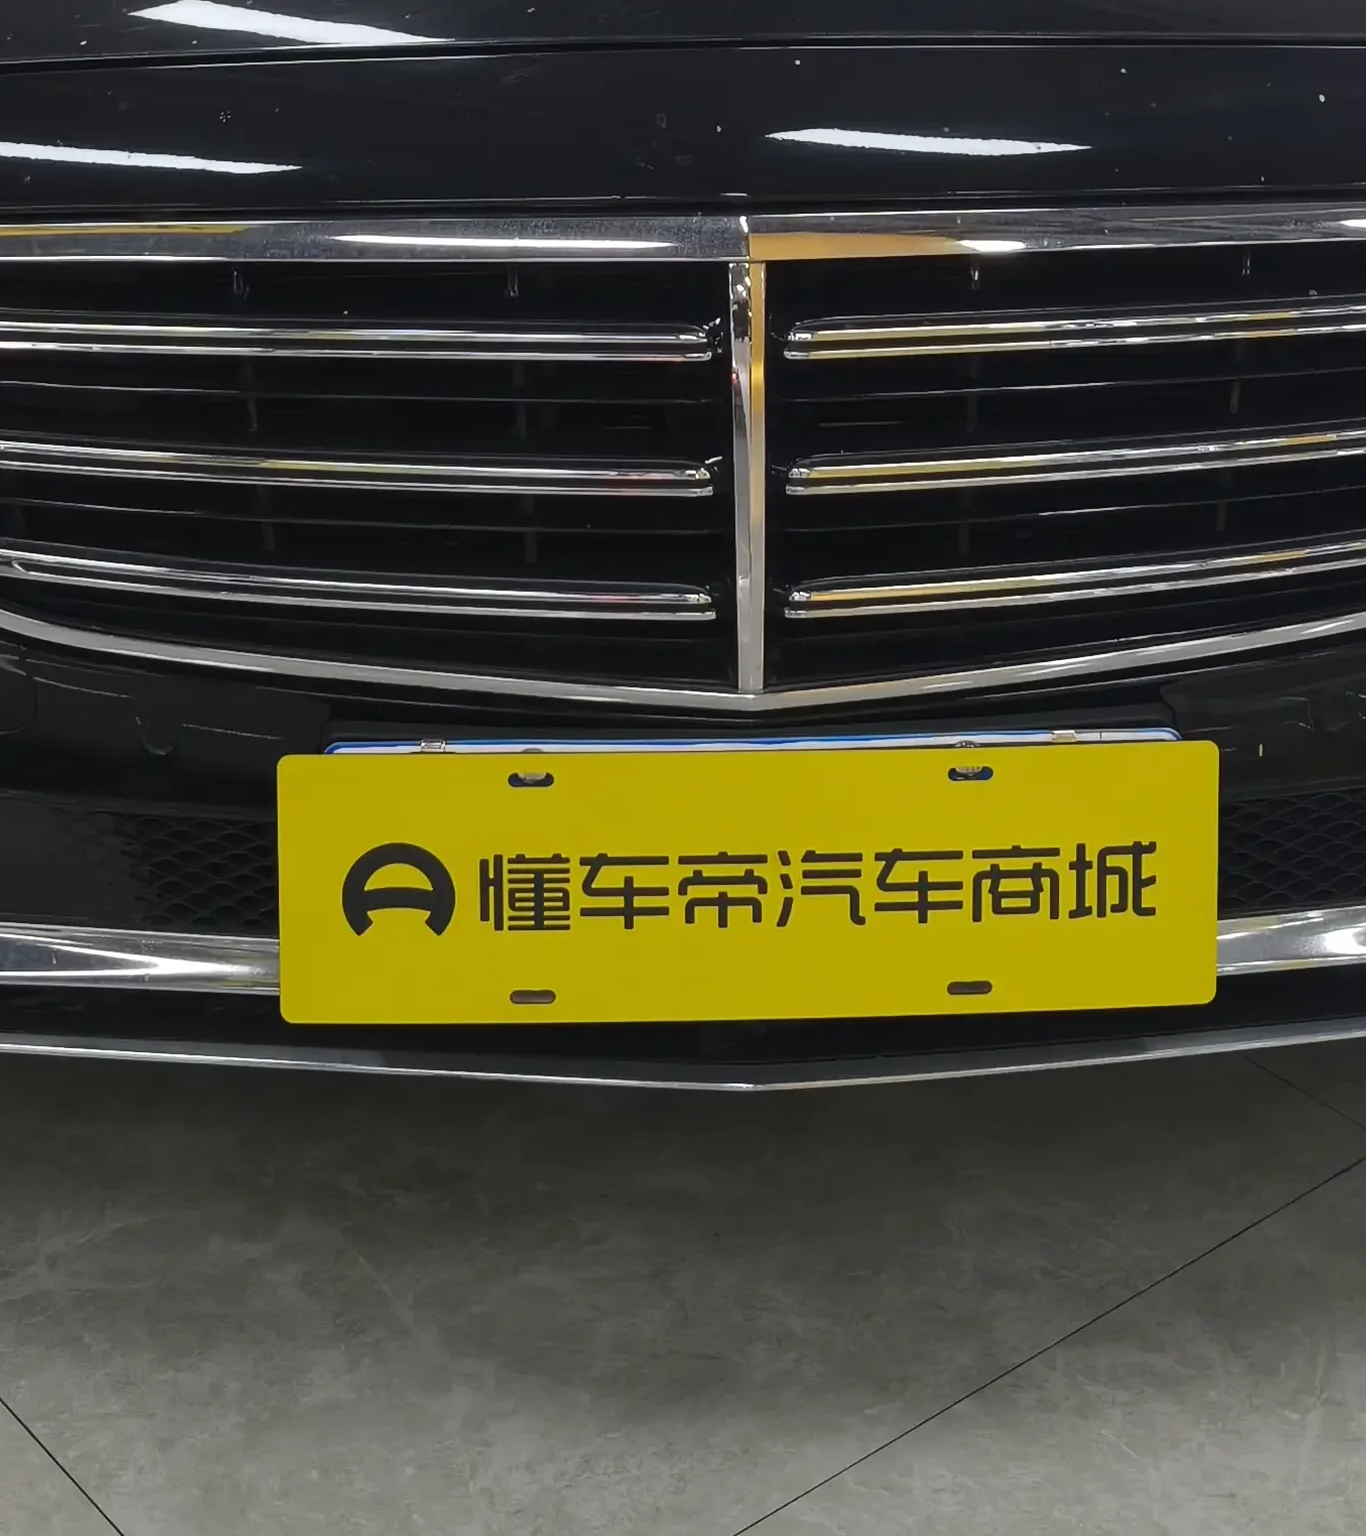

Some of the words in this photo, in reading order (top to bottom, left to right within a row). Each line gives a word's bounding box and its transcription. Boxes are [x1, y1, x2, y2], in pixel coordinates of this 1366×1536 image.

[479, 841, 1157, 931] 懂车帝汽车商城
